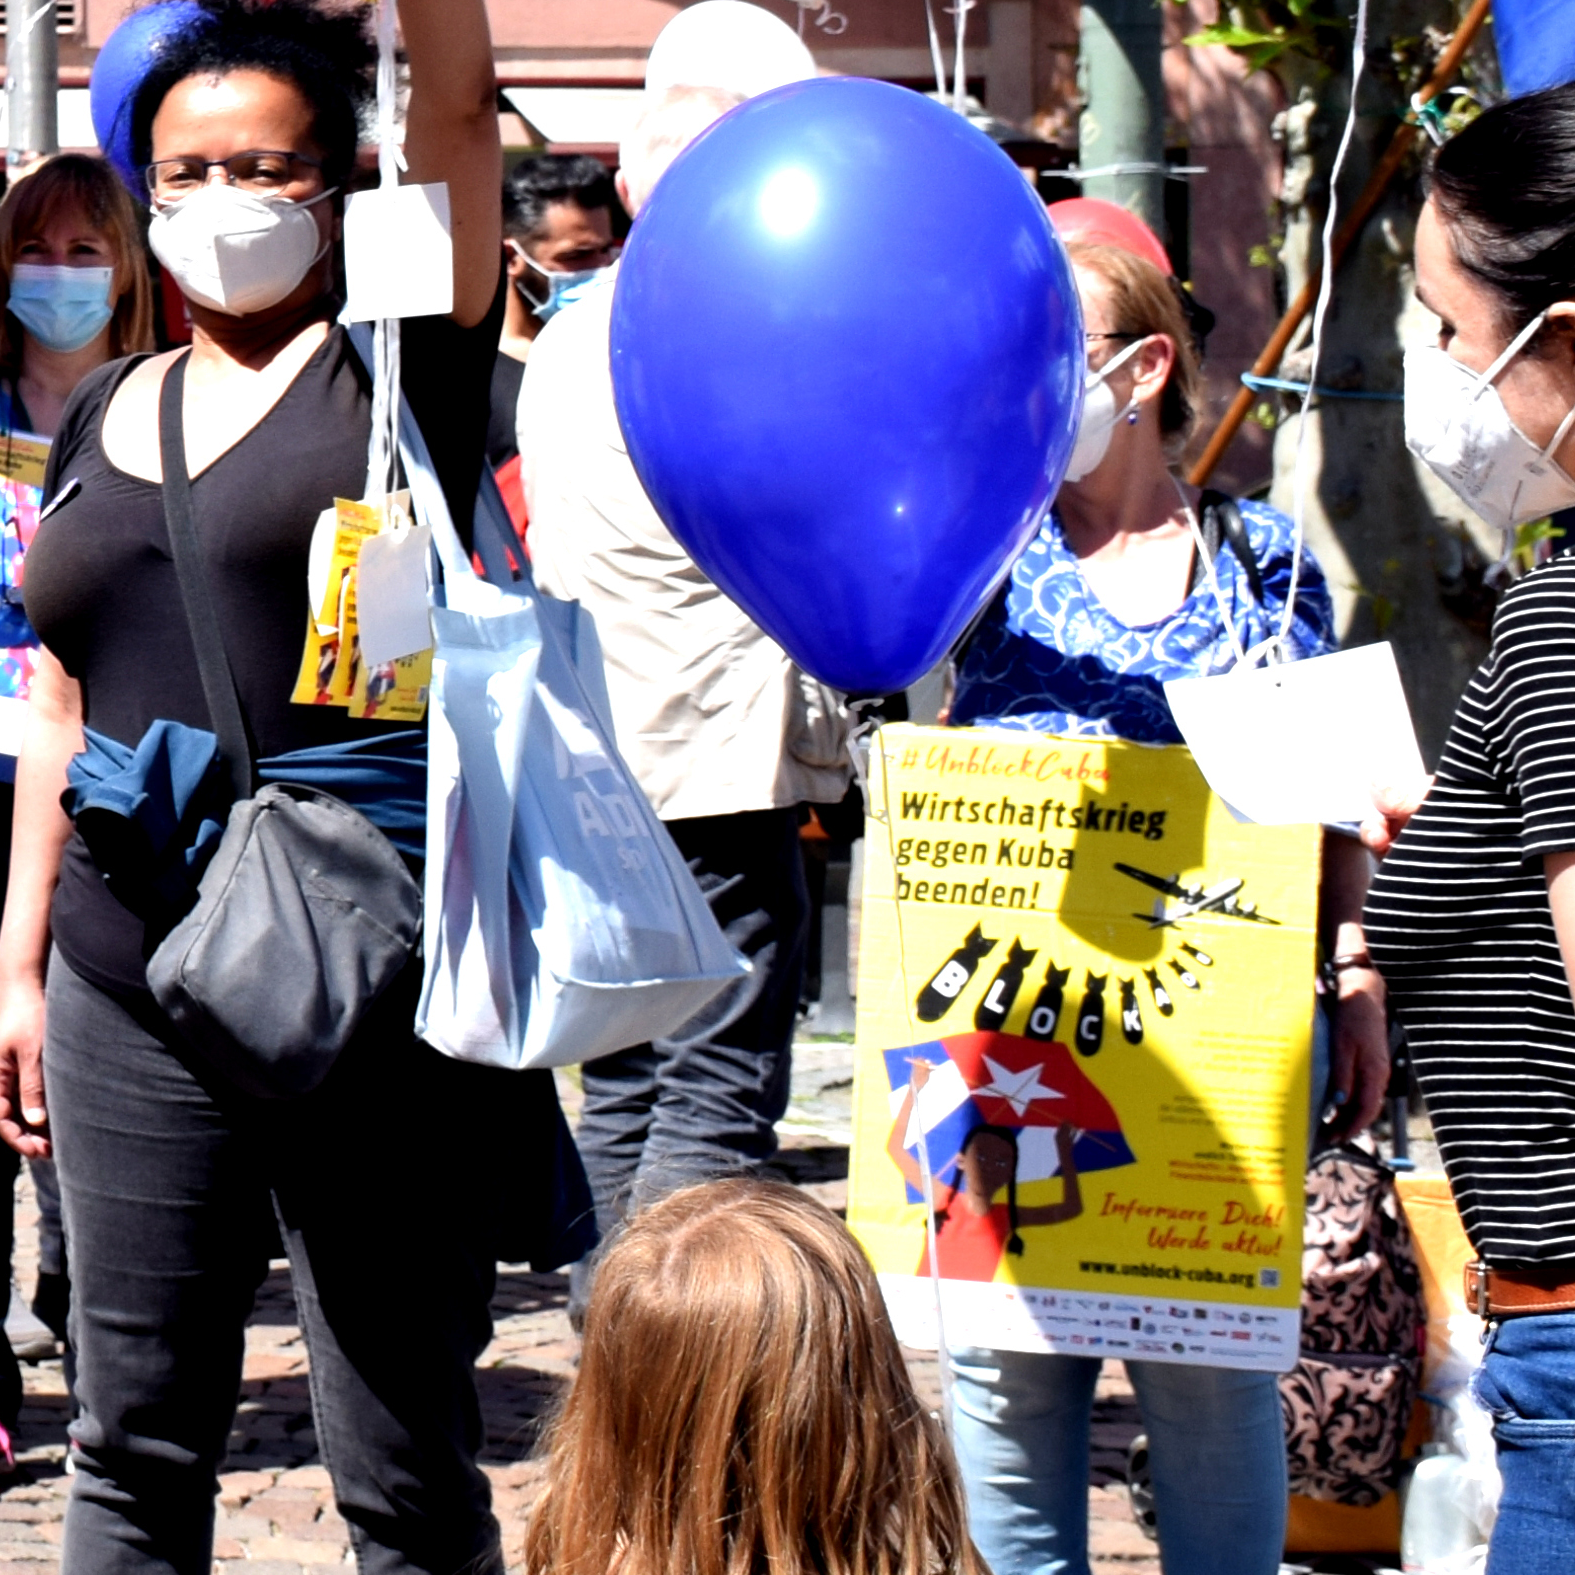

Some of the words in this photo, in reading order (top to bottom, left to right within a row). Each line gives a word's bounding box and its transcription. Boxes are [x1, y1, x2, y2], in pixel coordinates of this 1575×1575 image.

[901, 791, 1167, 841] Wirtschaftskrieg
[896, 837, 988, 868] gegen
[996, 838, 1076, 871] Kuba
[896, 872, 1040, 910] beenden!
[1220, 1200, 1286, 1229] Dich!
[1147, 1225, 1211, 1251] Werde
[1079, 1259, 1255, 1290] www.unblock-cuba.org
